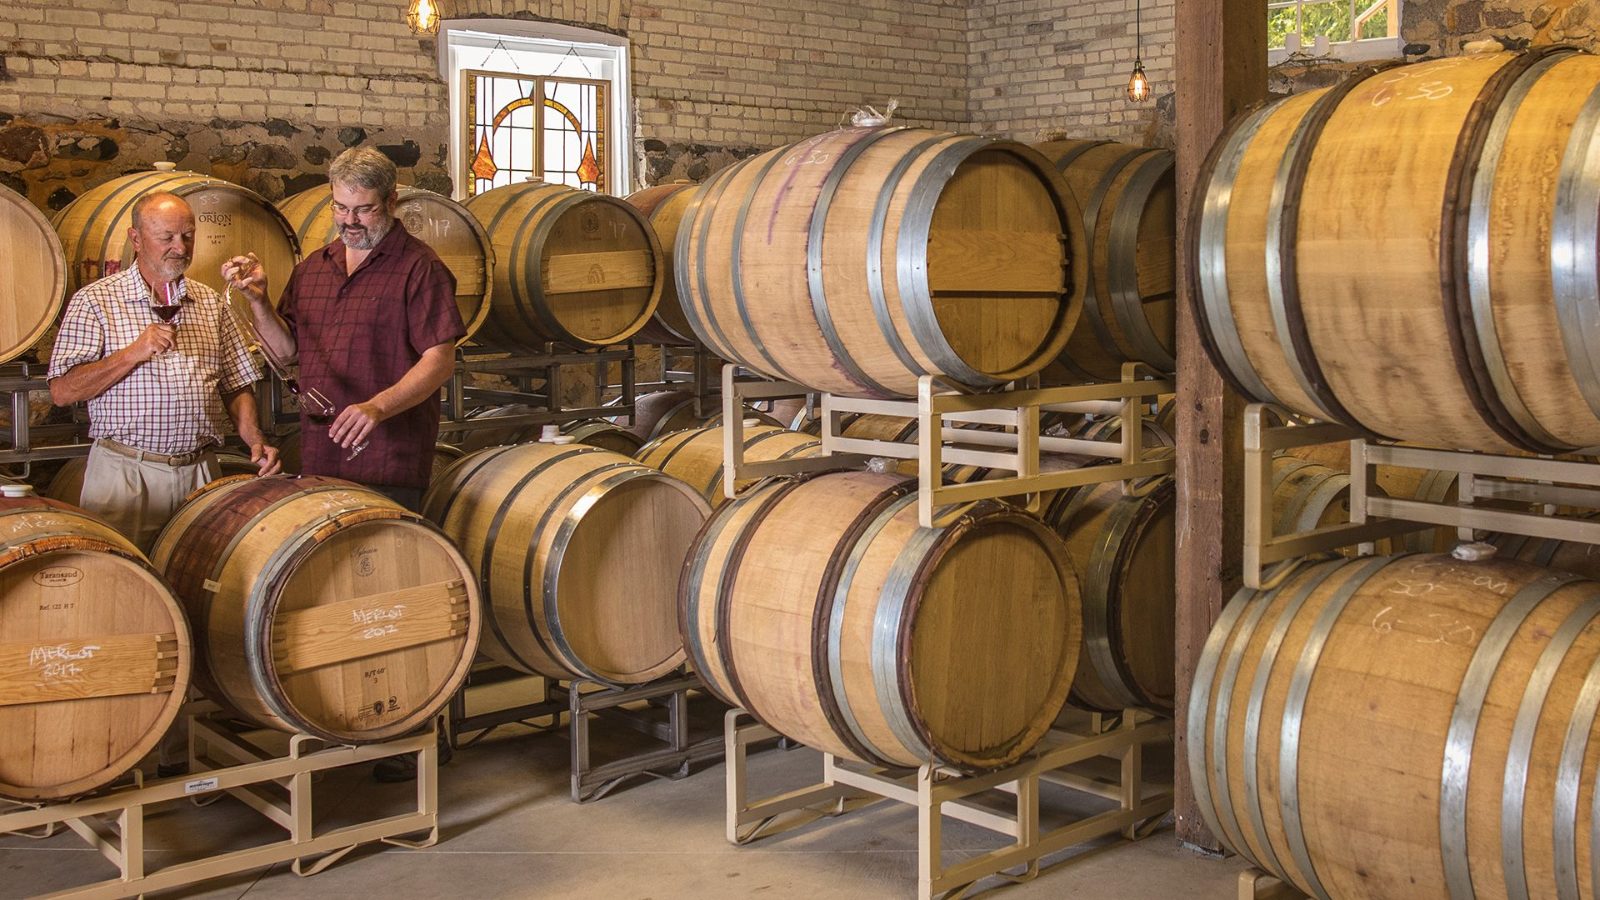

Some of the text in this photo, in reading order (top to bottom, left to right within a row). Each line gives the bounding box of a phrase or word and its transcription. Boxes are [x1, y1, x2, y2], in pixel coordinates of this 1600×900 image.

[198, 214, 232, 224] ORION
[353, 604, 407, 624] MERLOT
[30, 642, 101, 666] MERLOT
